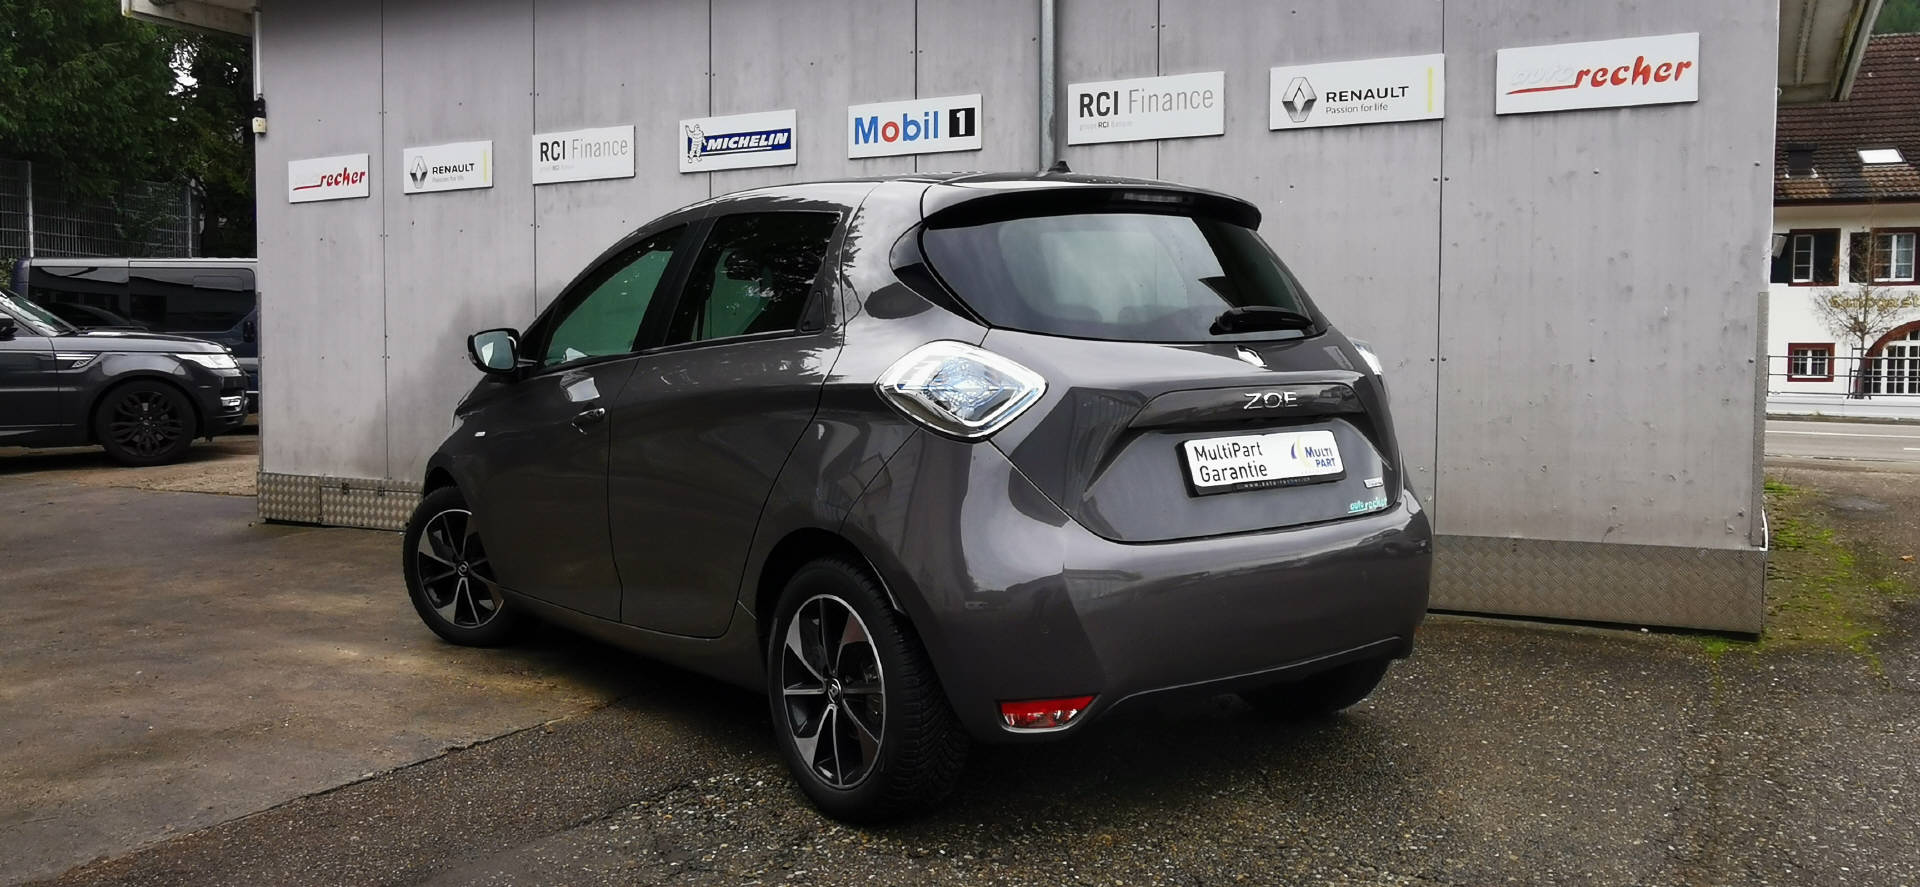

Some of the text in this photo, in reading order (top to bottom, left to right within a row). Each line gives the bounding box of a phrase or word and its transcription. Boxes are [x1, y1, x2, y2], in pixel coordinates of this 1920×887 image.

[1574, 56, 1693, 88] recher
[1079, 88, 1214, 118] RCI Finance
[1326, 86, 1410, 104] RENAULT
[1325, 102, 1389, 115] Passion for life
[854, 110, 939, 145] Mobil
[540, 138, 628, 162] RCI Finance
[706, 132, 789, 151] MICHELIN
[320, 167, 366, 187] recher
[432, 162, 475, 175] RENAULT
[1243, 391, 1299, 410] ZOE
[1193, 441, 1264, 463] MultiPart
[1199, 460, 1268, 483] Garantie
[1316, 457, 1336, 468] PART
